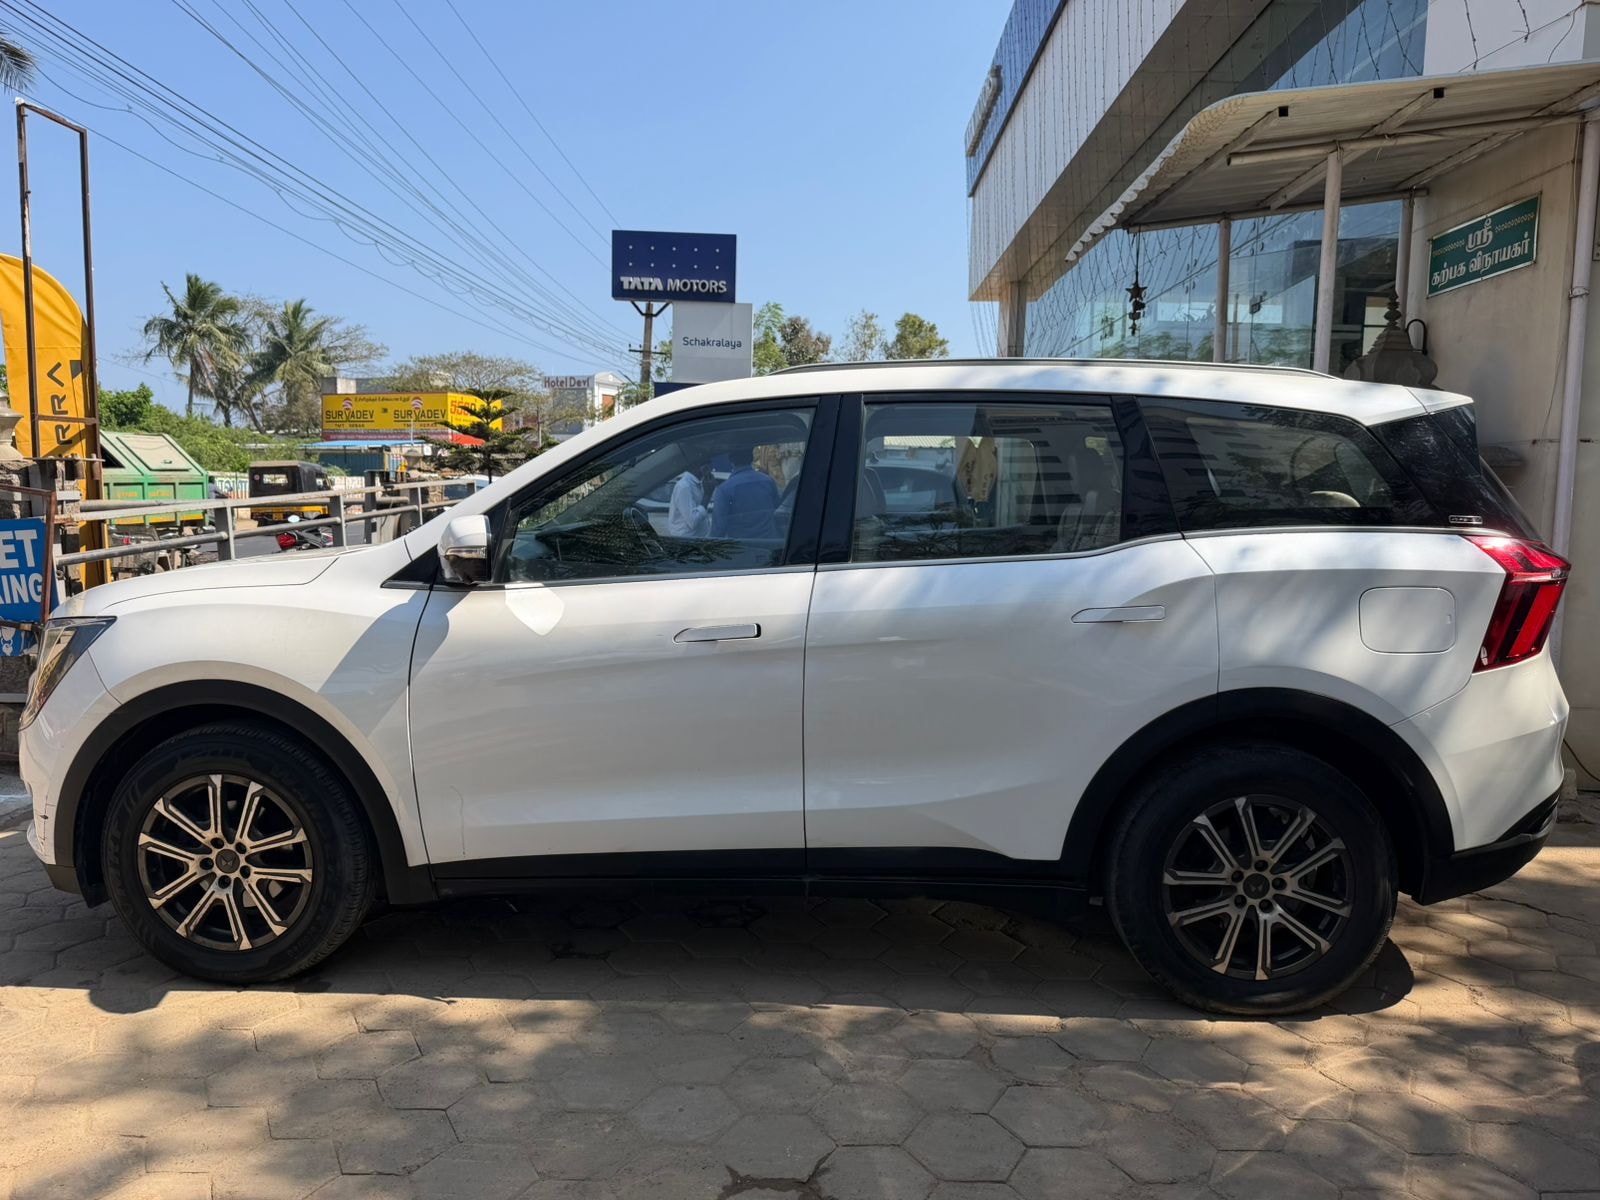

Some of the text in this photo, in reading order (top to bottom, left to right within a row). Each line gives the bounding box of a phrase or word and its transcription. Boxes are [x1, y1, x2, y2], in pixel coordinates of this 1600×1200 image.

[1465, 218, 1493, 253] ஸ்ரீ
[1431, 231, 1531, 288] கற்பக விநாயகர்
[620, 276, 728, 294] TATA MOTORS
[682, 336, 743, 350] Schakralaya
[544, 376, 591, 389] Hotel Devi
[325, 409, 376, 421] SURYADEV
[393, 409, 448, 421] SURYADEV
[0, 572, 43, 606] ING
